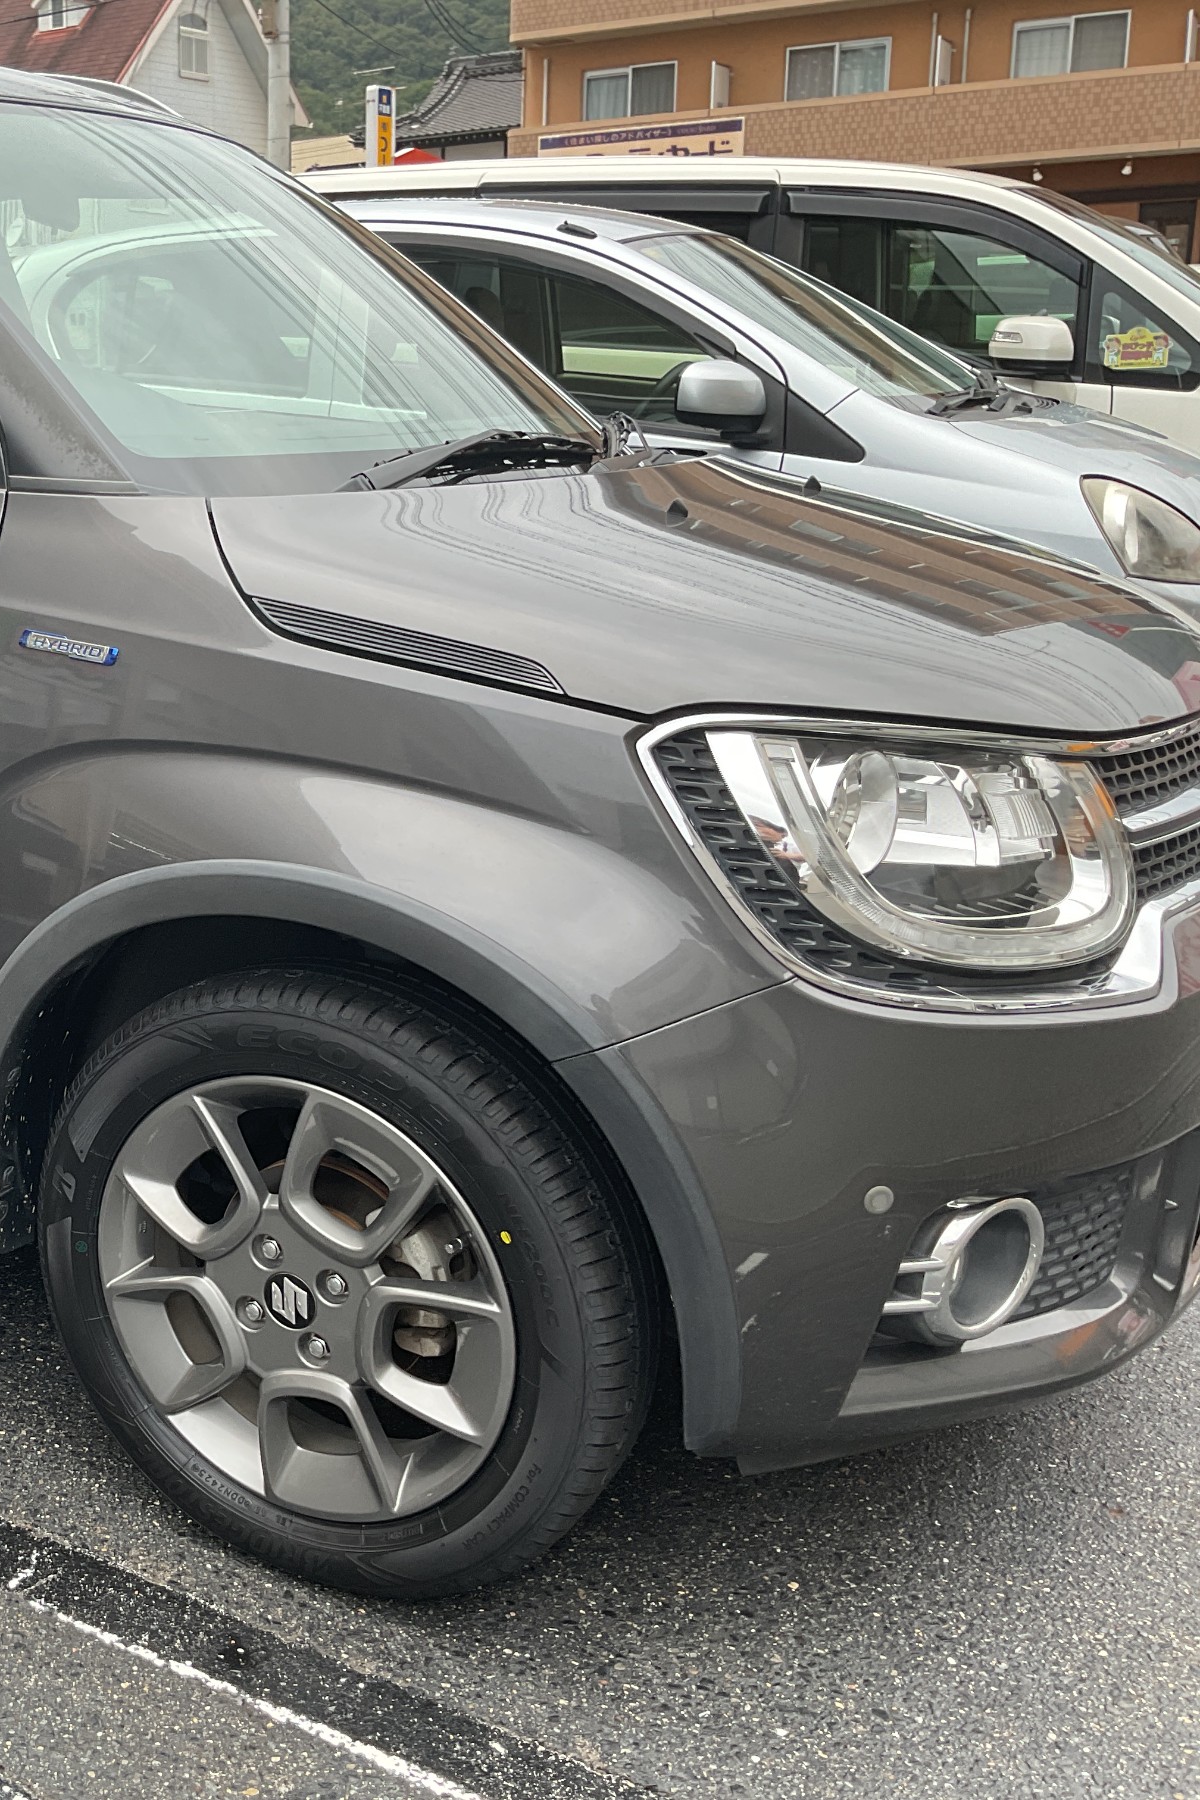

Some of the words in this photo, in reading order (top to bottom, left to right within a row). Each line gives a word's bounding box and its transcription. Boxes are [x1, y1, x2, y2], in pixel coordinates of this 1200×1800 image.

[33, 637, 102, 657] HYBRID
[526, 1463, 543, 1484] For
[486, 1485, 530, 1534] COMPACT
[462, 1531, 486, 1551] CAR
